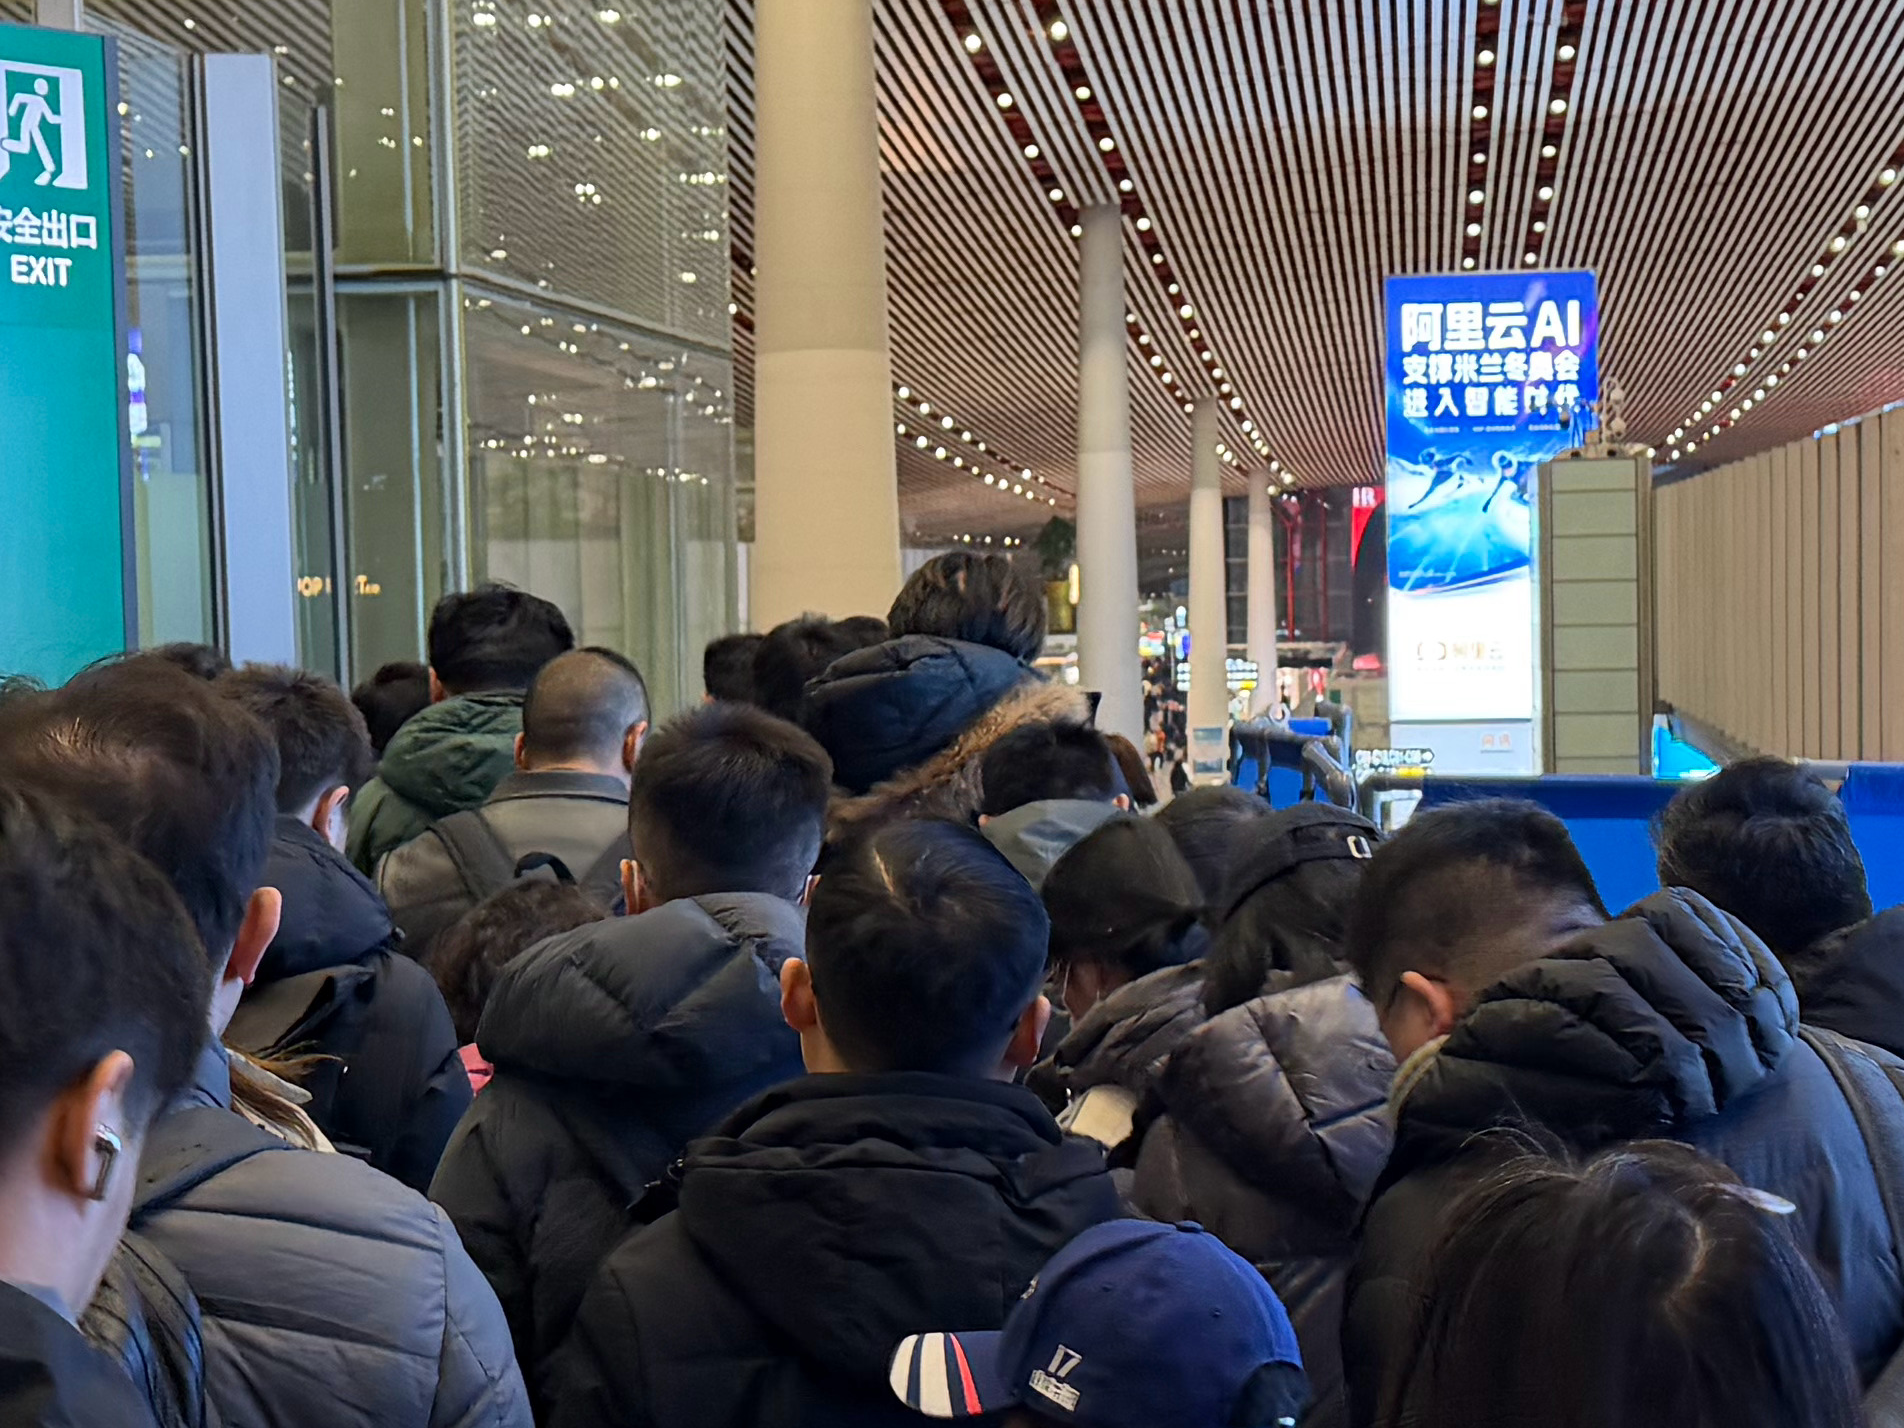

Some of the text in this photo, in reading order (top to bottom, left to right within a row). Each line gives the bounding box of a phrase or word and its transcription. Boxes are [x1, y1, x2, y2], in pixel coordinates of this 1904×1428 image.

[10, 254, 72, 287] EXIT
[1401, 300, 1580, 353] 阿里云AI
